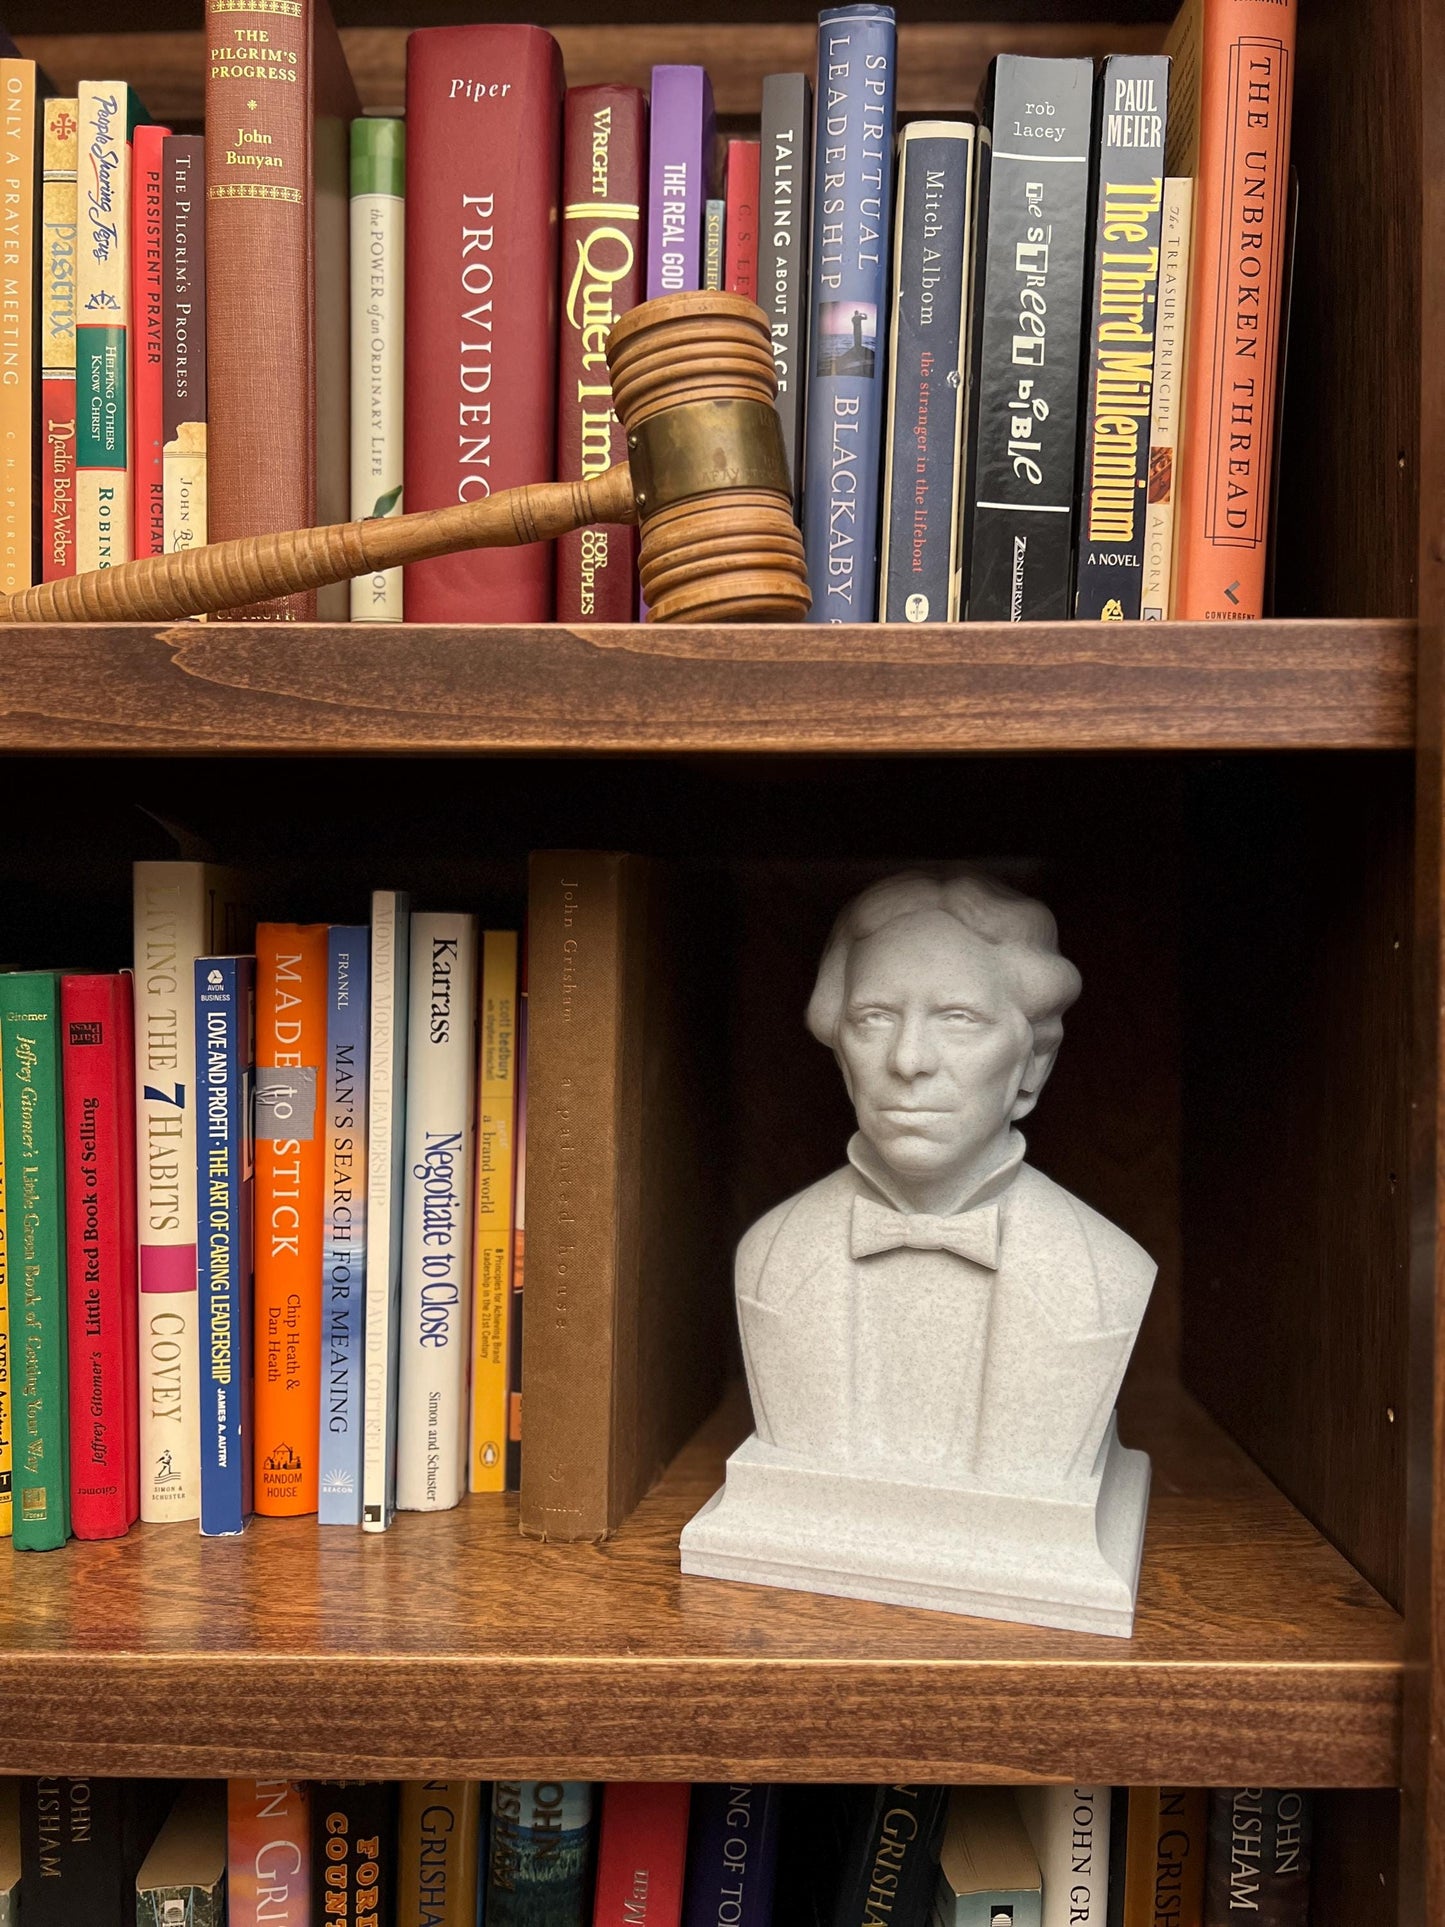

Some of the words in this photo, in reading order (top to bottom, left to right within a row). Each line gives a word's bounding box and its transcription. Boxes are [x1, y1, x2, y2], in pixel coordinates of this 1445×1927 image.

[211, 47, 298, 64] PILGRIM'S
[234, 29, 269, 43] THE
[211, 66, 297, 82] PROGRESS
[448, 79, 511, 103] Piper
[1115, 79, 1158, 112] PAUL
[1247, 57, 1272, 129] THE
[5, 77, 22, 140] ONLY
[90, 95, 118, 146] People
[1025, 101, 1056, 116] rob
[234, 128, 272, 147] John
[592, 106, 611, 197] WRIGHT
[1013, 121, 1066, 142] lacey
[1107, 115, 1162, 148] MEIER
[6, 152, 20, 164] A
[88, 143, 119, 212] Sharing
[175, 155, 191, 193] THE
[226, 151, 283, 170] Bunyan
[663, 162, 687, 197] THE
[821, 35, 850, 290] LEADERSHIP
[857, 54, 887, 271] SPIRITUAL
[773, 130, 793, 248] TALKING
[923, 170, 945, 239] Mitch
[1103, 177, 1162, 243] The
[4, 179, 20, 264] PRAYER
[146, 171, 162, 285] PERSISTENT
[370, 208, 382, 227] the
[662, 201, 686, 248] REAL
[739, 204, 751, 221] C.
[1168, 206, 1180, 230] The
[88, 206, 118, 266] Jesus
[175, 201, 192, 294] PILGRIM'S
[738, 231, 751, 246] S.
[1235, 150, 1267, 360] UNBROKEN
[370, 231, 385, 299] POWER
[661, 252, 685, 290] GOD
[774, 257, 788, 315] ABOUT
[920, 247, 942, 326] Albom
[1163, 236, 1180, 331] TREASURE
[366, 303, 385, 317] of
[1098, 246, 1159, 342] Third
[3, 278, 19, 386] MEETING
[147, 293, 162, 364] PRAYER
[370, 319, 380, 334] an
[175, 303, 192, 399] PROGRESS
[771, 323, 788, 393] RACE
[920, 351, 935, 378] the
[370, 338, 385, 430] ORDINARY
[1158, 337, 1175, 433] PRINCIPLE
[913, 380, 932, 454] stranger
[48, 419, 75, 474] Nadia
[371, 436, 385, 477] LIFE
[916, 456, 930, 474] in
[1088, 347, 1153, 542] Millennium
[1225, 378, 1255, 530] THREAD
[179, 478, 193, 522] JOHN
[827, 395, 860, 605] BLACKABY
[915, 478, 928, 505] the
[594, 531, 608, 569] FOR
[912, 508, 928, 573] lifeboat
[1088, 553, 1096, 566] A
[1099, 553, 1140, 567] NOVEL
[1149, 516, 1165, 594] ALCORN
[580, 530, 595, 615] COUPLES
[560, 879, 578, 928] John
[200, 994, 231, 1002] BUSINESS
[207, 983, 225, 992] AVON
[337, 953, 350, 1010] FRANKL
[429, 937, 458, 1045] Karrass
[562, 938, 578, 1024] Grisham
[70, 1023, 101, 1034] Press
[207, 1011, 228, 1049] LOVE
[274, 953, 302, 1068] MADE
[16, 1034, 38, 1083] Jeffrey
[70, 1033, 101, 1044] Bard
[146, 1008, 178, 1071] THE
[207, 1050, 228, 1084] AND
[144, 1083, 186, 1110] 7
[208, 1086, 229, 1141] PROFIT
[273, 1085, 298, 1120] to
[80, 1097, 100, 1162] Selling
[482, 1115, 492, 1123] a
[148, 1113, 184, 1232] HABITS
[209, 1146, 228, 1177] THE
[482, 1131, 497, 1173] brand
[85, 1167, 97, 1188] of
[209, 1180, 229, 1209] ART
[271, 1138, 300, 1256] STICK
[331, 1138, 353, 1242] SEARCH
[413, 1131, 463, 1247] Negotiate
[480, 1177, 495, 1214] world
[83, 1193, 98, 1242] Book
[209, 1211, 230, 1232] OF
[84, 1244, 99, 1284] Red
[210, 1234, 230, 1291] CARING
[331, 1251, 351, 1301] FOR
[422, 1253, 457, 1277] to
[482, 1248, 493, 1288] Leadership
[87, 1288, 100, 1338] Little
[268, 1307, 281, 1336] Dan
[286, 1294, 300, 1330] Chip
[366, 1289, 386, 1352] DAVID
[419, 1282, 460, 1348] Close
[210, 1295, 231, 1384] LEADERSHIP
[267, 1339, 281, 1383] Heath
[286, 1333, 300, 1376] Heath
[480, 1331, 491, 1359] Century
[492, 1342, 502, 1364] Brand
[90, 1351, 104, 1418] Gitomer's
[149, 1312, 186, 1424] COVEY
[286, 1378, 300, 1390] &
[328, 1310, 351, 1434] MEANING
[217, 1388, 227, 1422] JAMES
[428, 1391, 441, 1425] Simon
[91, 1421, 107, 1466] Jeffrey
[217, 1423, 227, 1434] A.
[427, 1427, 440, 1450] and
[217, 1435, 228, 1468] AUTRY
[77, 1485, 118, 1495] Gitomer
[263, 1473, 303, 1485] RANDOM
[266, 1486, 298, 1498] HOUSE
[322, 1486, 353, 1494] BEACON
[425, 1451, 441, 1502] Schuster
[1072, 1788, 1095, 1876] JOHN
[418, 1805, 455, 1926] GRISHA
[723, 1838, 748, 1875] OF
[861, 1808, 918, 1926] GRISHA
[255, 1840, 302, 1926] GRI
[717, 1882, 743, 1926] TO
[1069, 1885, 1092, 1926] GR
